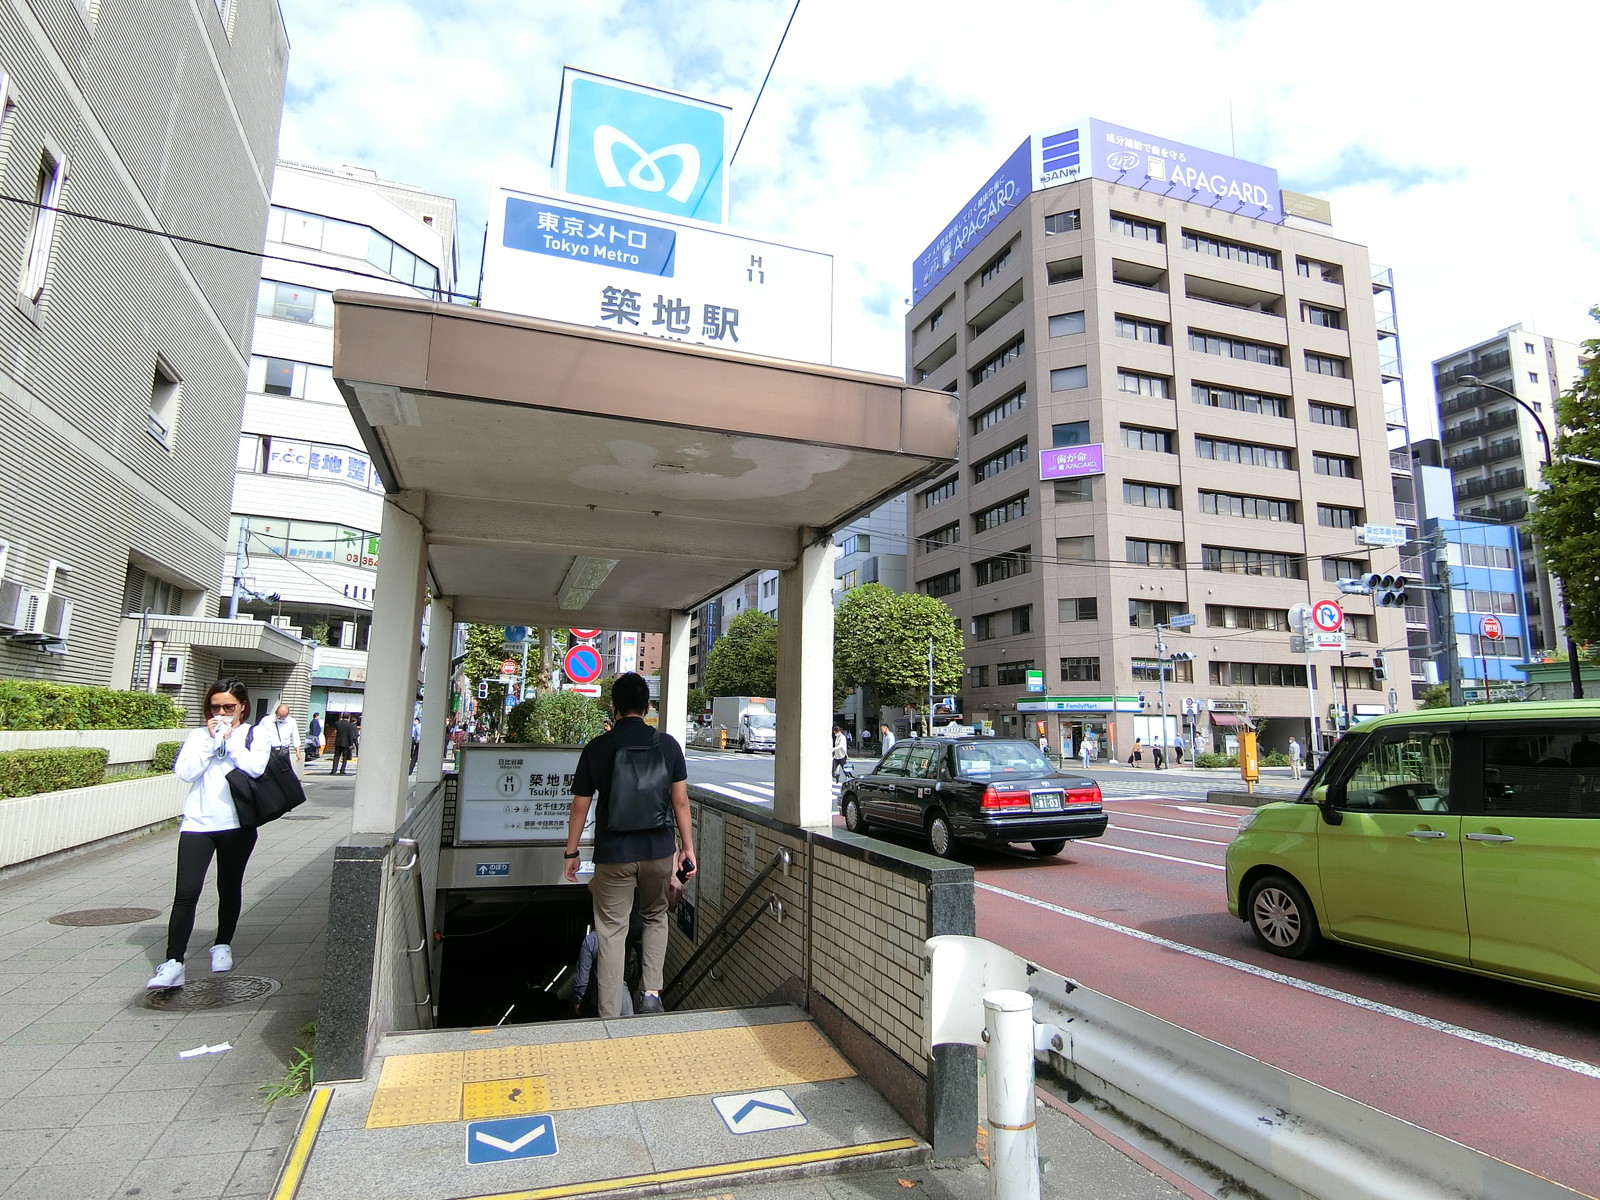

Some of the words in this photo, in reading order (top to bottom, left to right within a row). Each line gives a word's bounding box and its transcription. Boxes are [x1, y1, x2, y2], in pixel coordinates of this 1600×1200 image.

[536, 211, 648, 250] 東京メトロ
[542, 234, 590, 256] Tokyo
[593, 244, 640, 265] Metro
[750, 254, 763, 269] H
[746, 268, 765, 285] 11
[600, 285, 740, 344] 築地駅
[271, 451, 308, 466] F.C.C.
[346, 553, 359, 563] 03
[1065, 702, 1098, 711] FamilyMart
[504, 784, 515, 792] 11
[529, 787, 559, 798] Tsukiji
